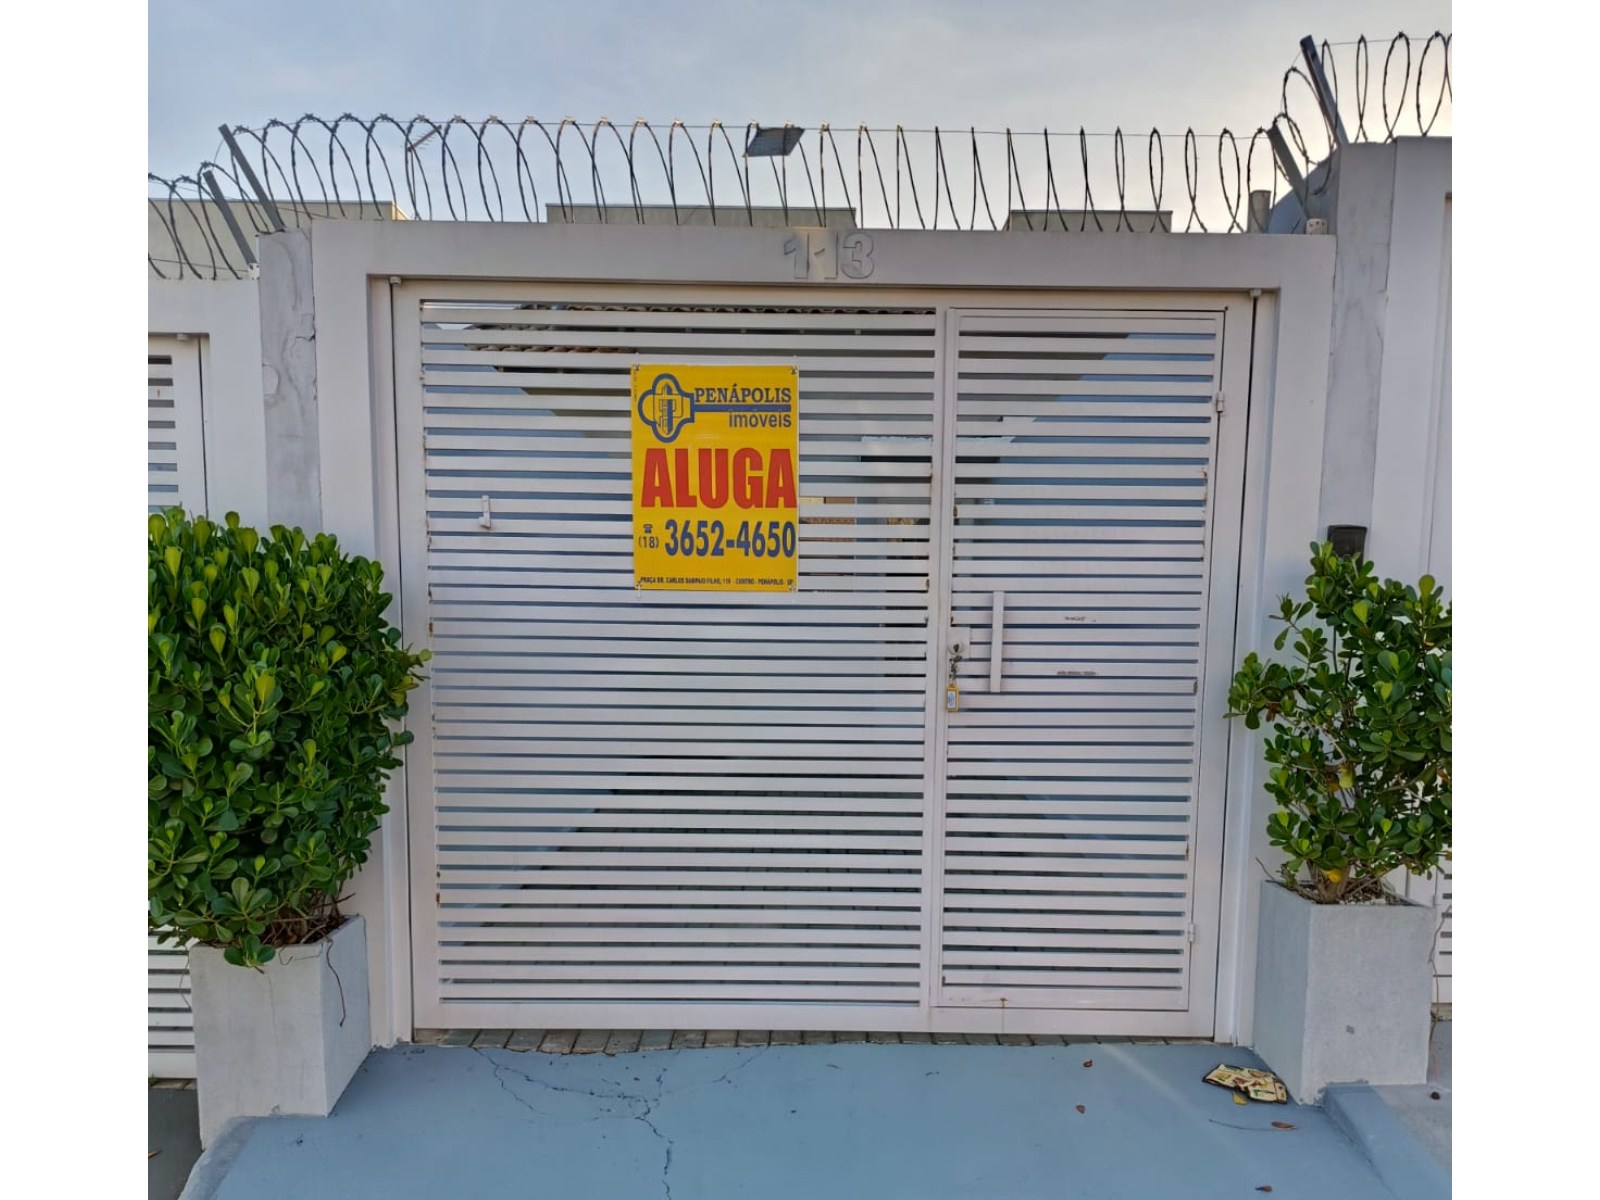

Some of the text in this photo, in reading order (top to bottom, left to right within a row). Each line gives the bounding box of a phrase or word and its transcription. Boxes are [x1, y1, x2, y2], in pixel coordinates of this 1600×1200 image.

[783, 232, 875, 280] 113
[694, 384, 792, 403] PENÁPOLIS
[728, 410, 792, 428] imóveis
[641, 447, 798, 509] ALUGA
[638, 519, 796, 558] (18) 3652-4650
